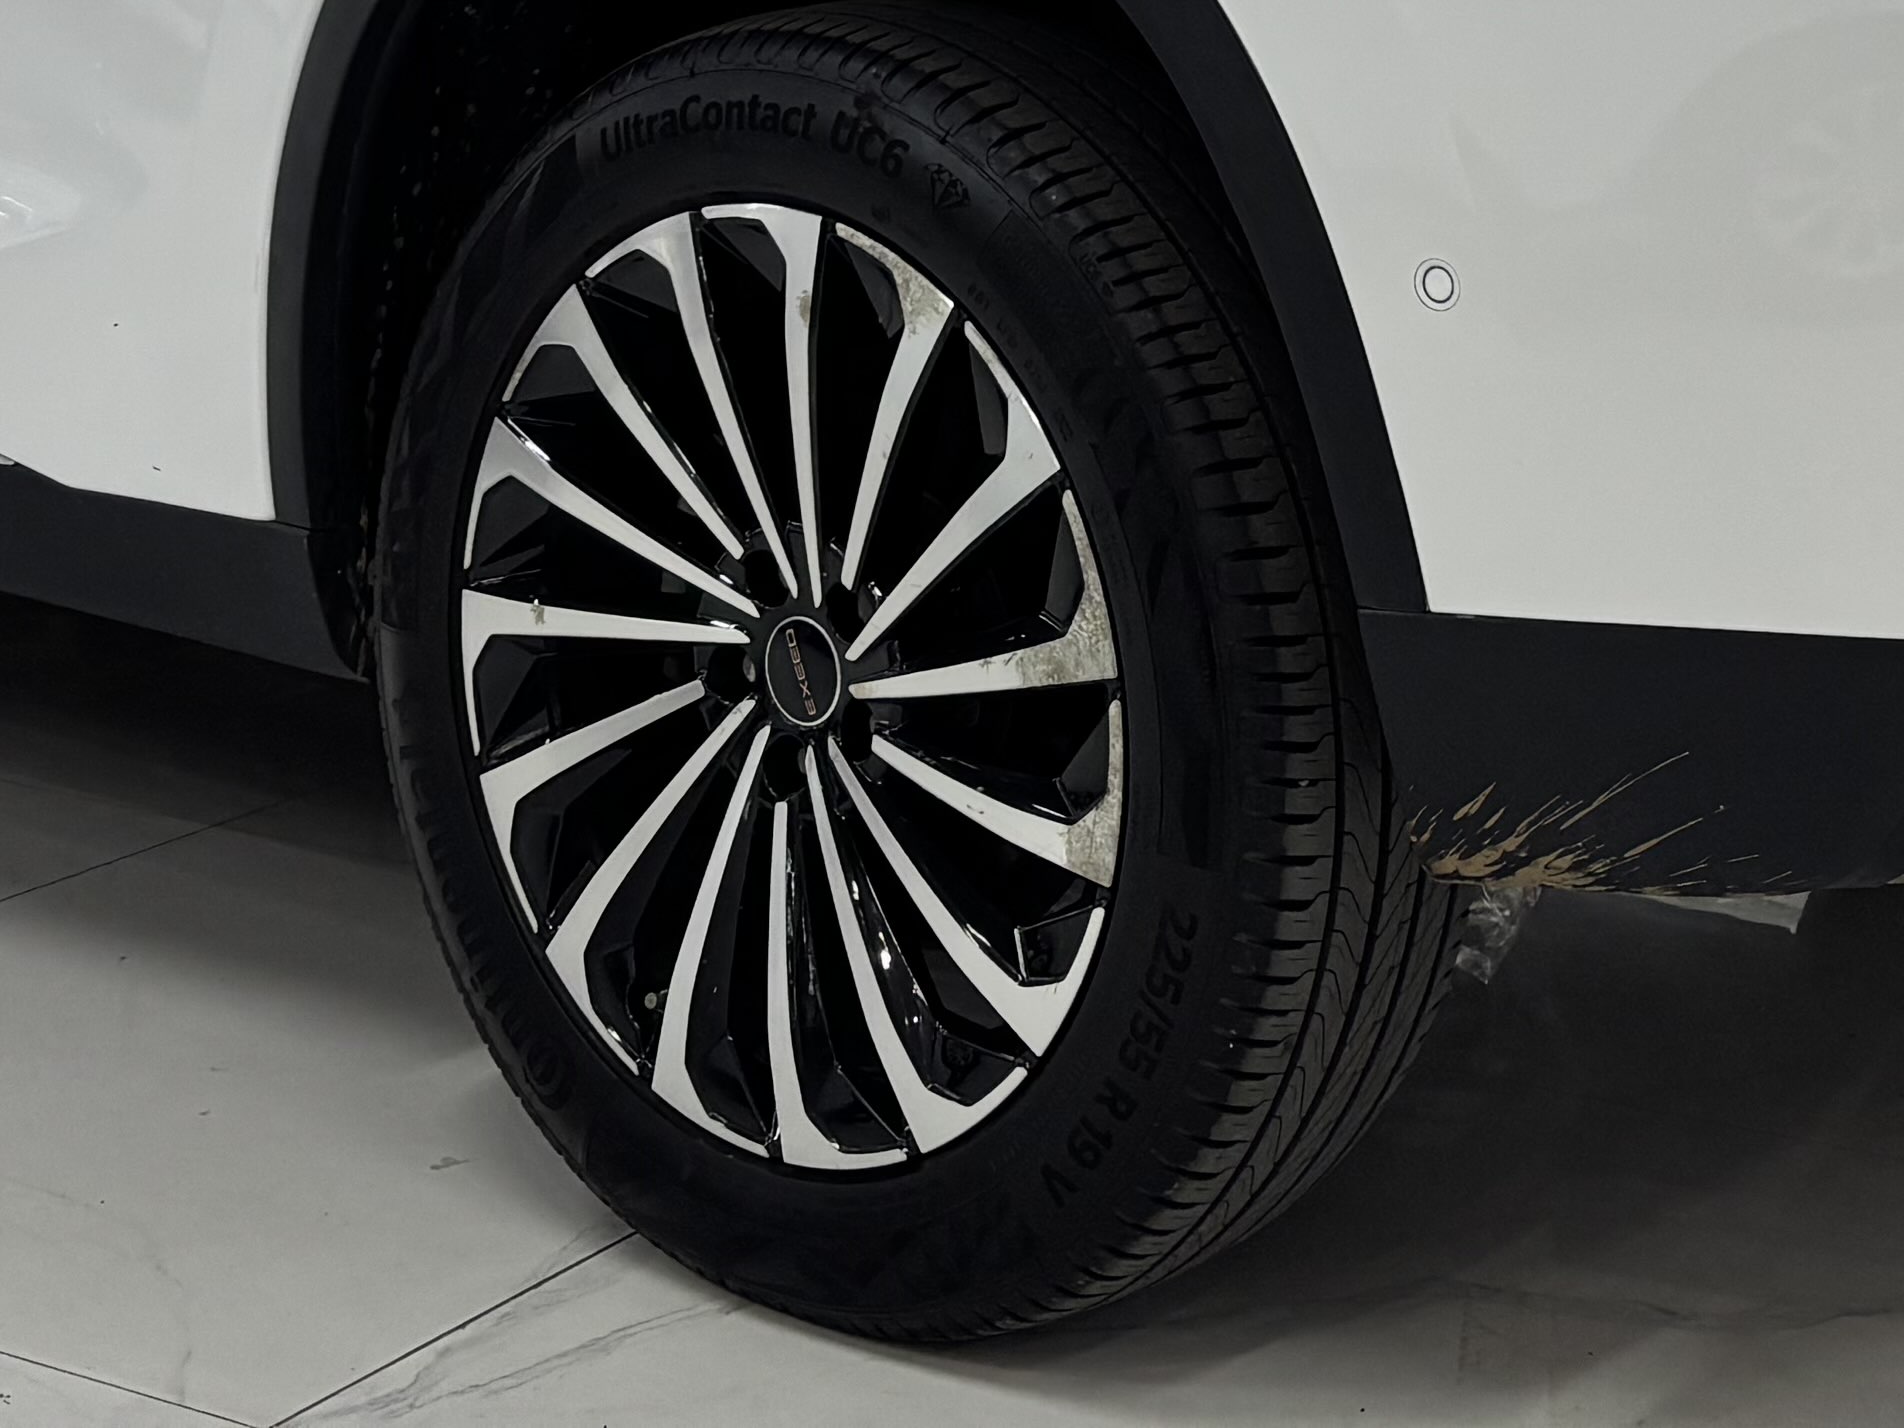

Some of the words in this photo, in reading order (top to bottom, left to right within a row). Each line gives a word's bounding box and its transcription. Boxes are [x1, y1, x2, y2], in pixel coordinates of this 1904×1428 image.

[600, 94, 818, 163] UltraContact
[831, 108, 911, 179] UC6
[784, 627, 818, 717] EXEED
[1118, 900, 1199, 1081] 225/55
[1040, 1162, 1081, 1209] V
